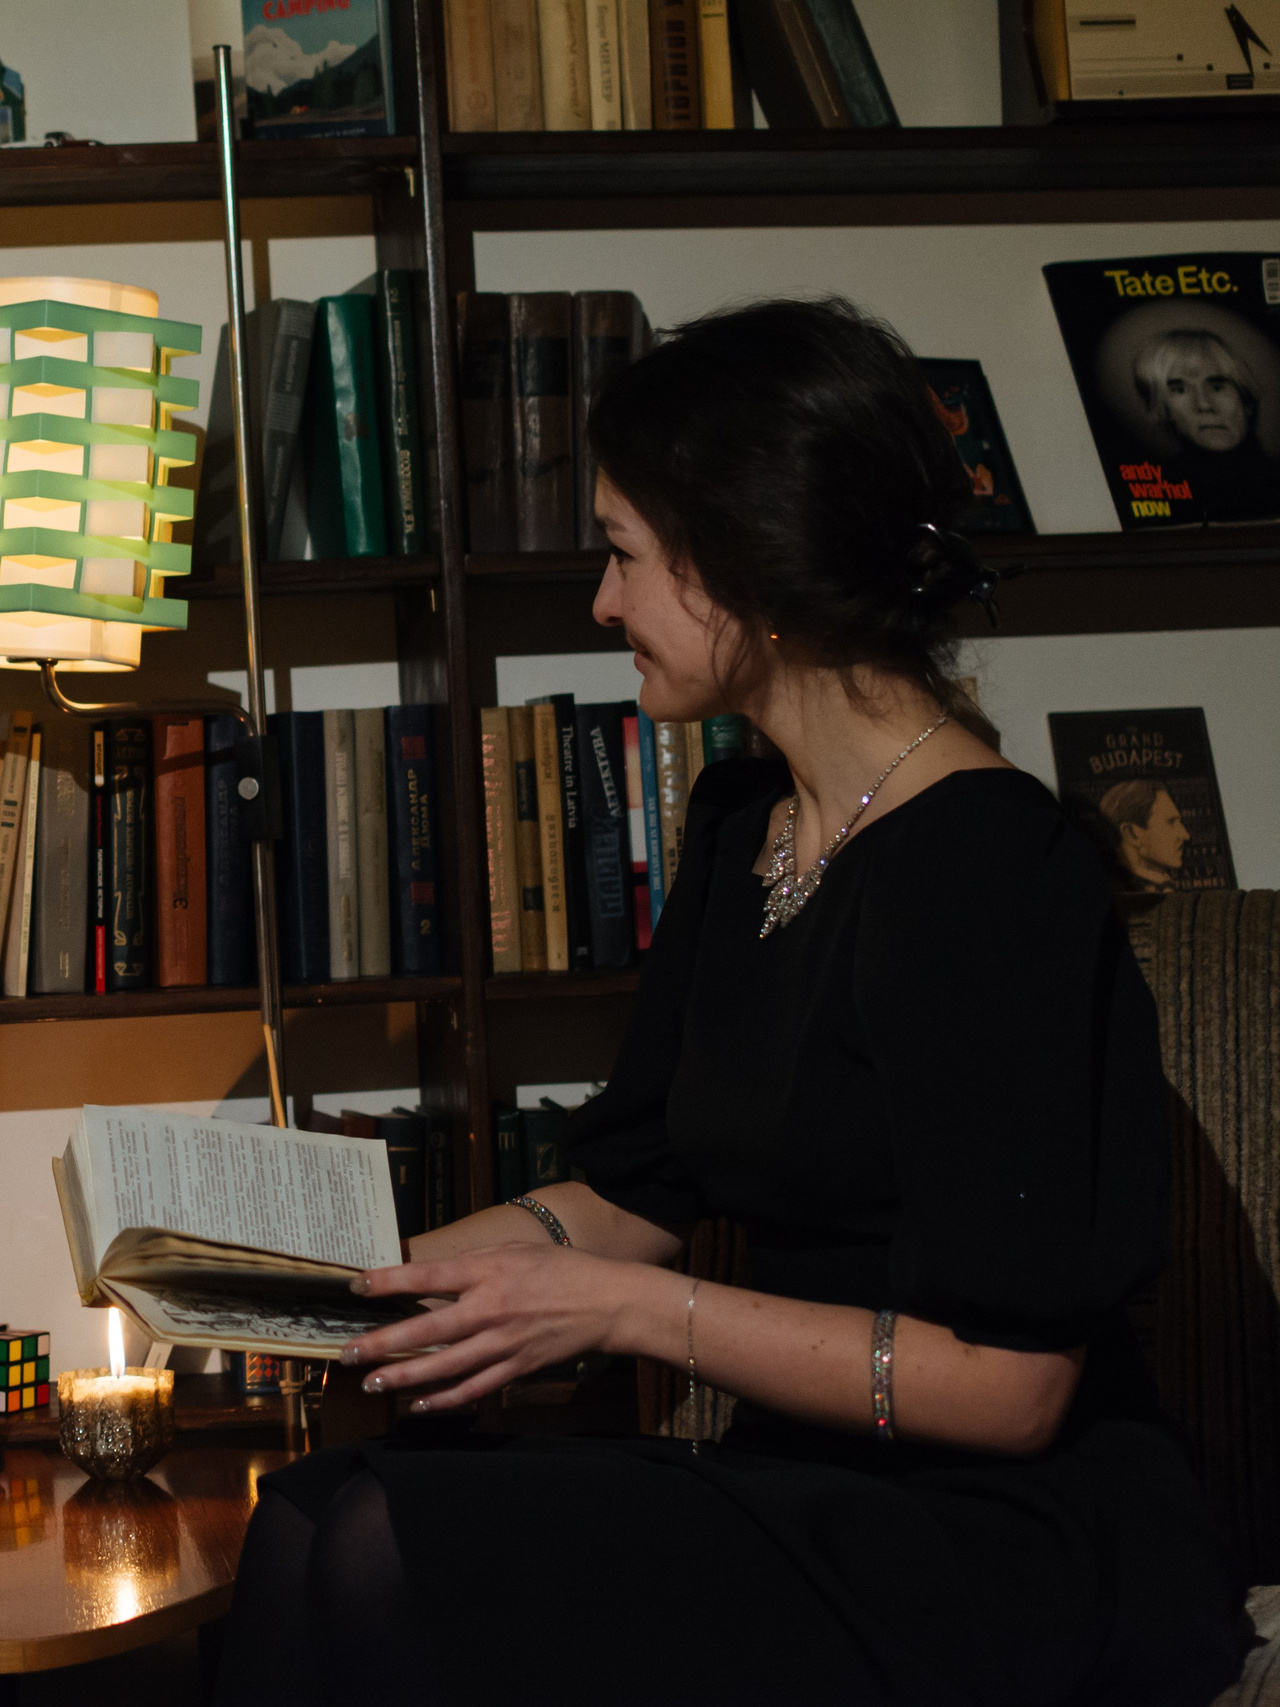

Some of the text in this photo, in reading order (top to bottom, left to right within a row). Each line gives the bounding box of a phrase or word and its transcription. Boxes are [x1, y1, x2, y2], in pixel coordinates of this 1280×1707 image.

[262, 0, 351, 21] CAMPING
[1104, 265, 1239, 298] Tate Etc.
[1119, 461, 1162, 484] andy
[1129, 479, 1193, 500] warhol
[1131, 500, 1172, 518] now
[1105, 731, 1165, 749] GRAND
[1088, 747, 1184, 775] BUDAPEST
[561, 724, 579, 829] Theatre in Latvia
[406, 767, 423, 871] АЛЕКСАНДР
[419, 793, 431, 849] ДЮМА
[650, 839, 661, 875] CATCHER
